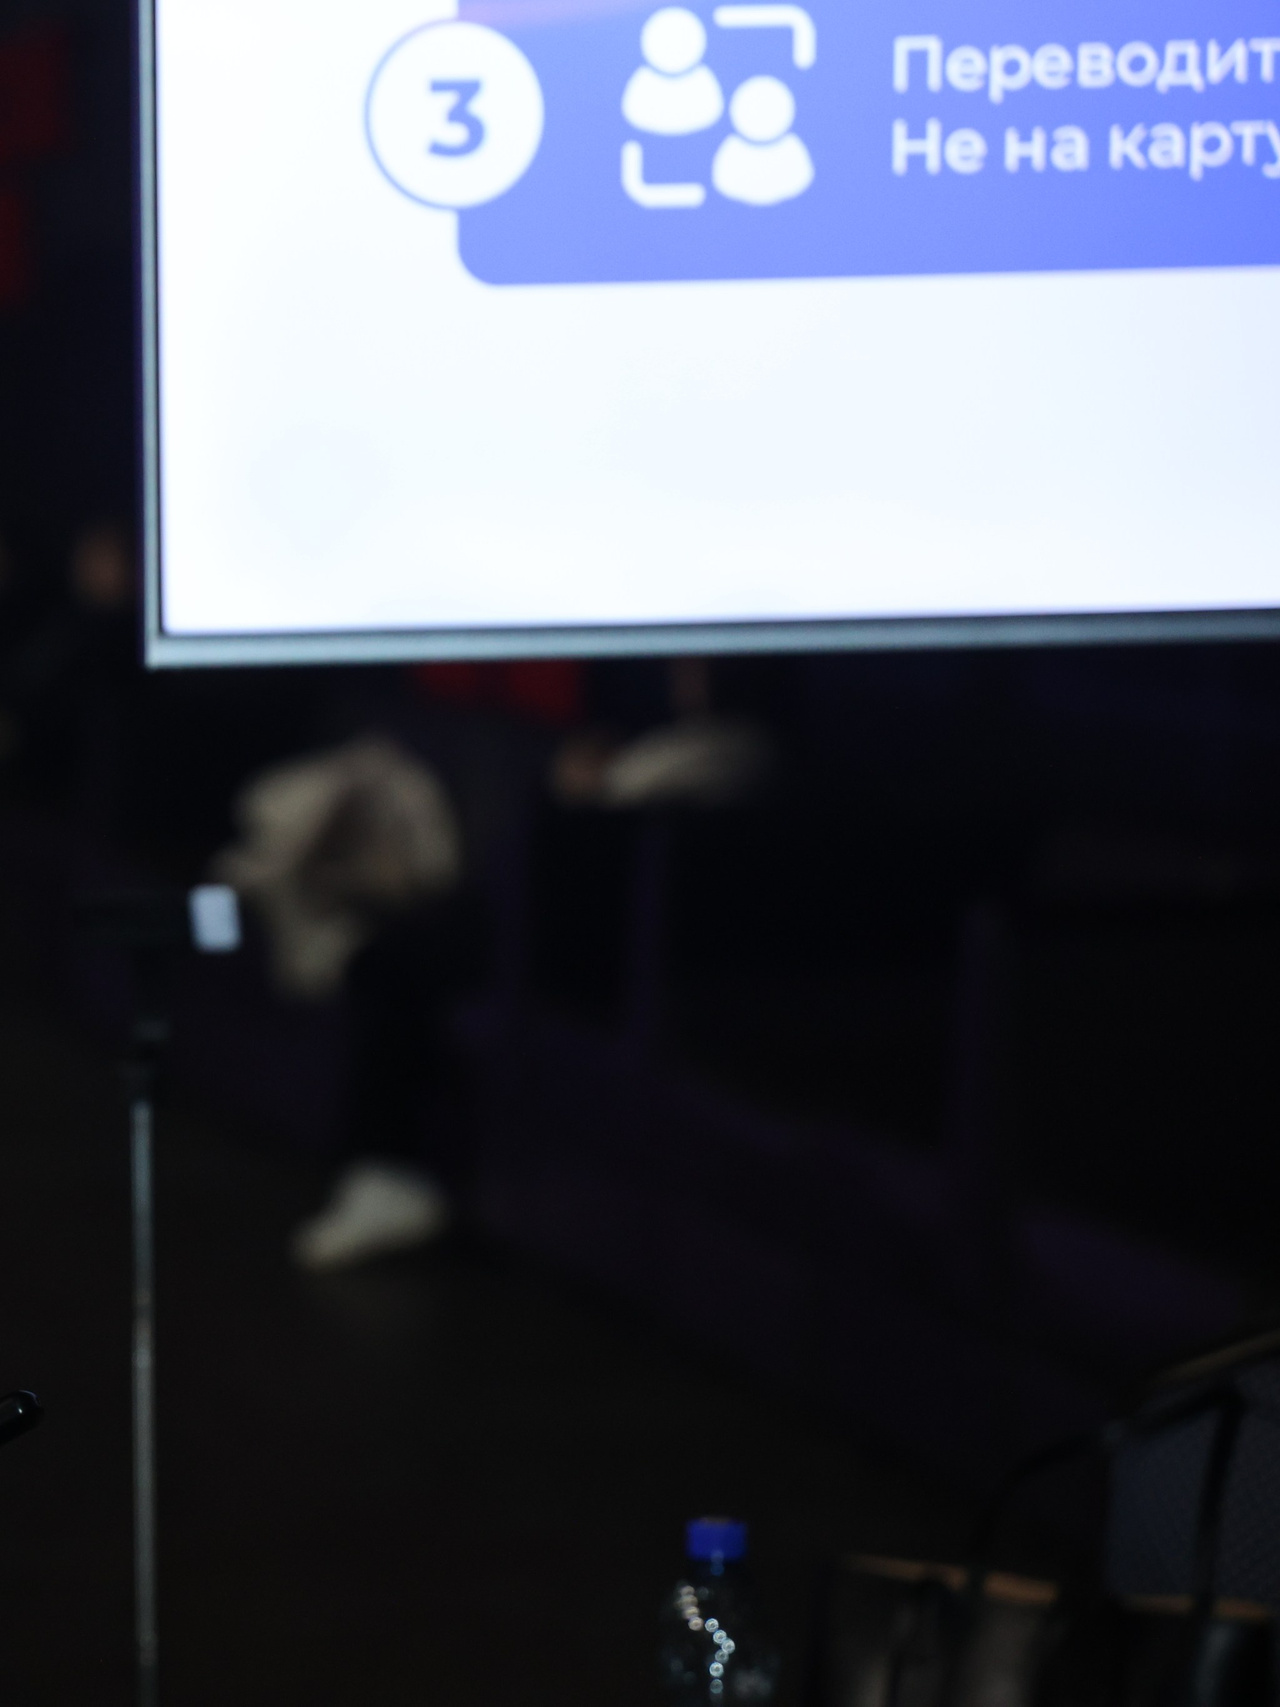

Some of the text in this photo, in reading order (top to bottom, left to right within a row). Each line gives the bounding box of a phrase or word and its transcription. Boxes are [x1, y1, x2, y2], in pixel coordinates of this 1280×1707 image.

[891, 34, 1280, 103] Переводит
[425, 77, 488, 158] 3
[891, 118, 987, 176] Не
[1003, 124, 1091, 173] на
